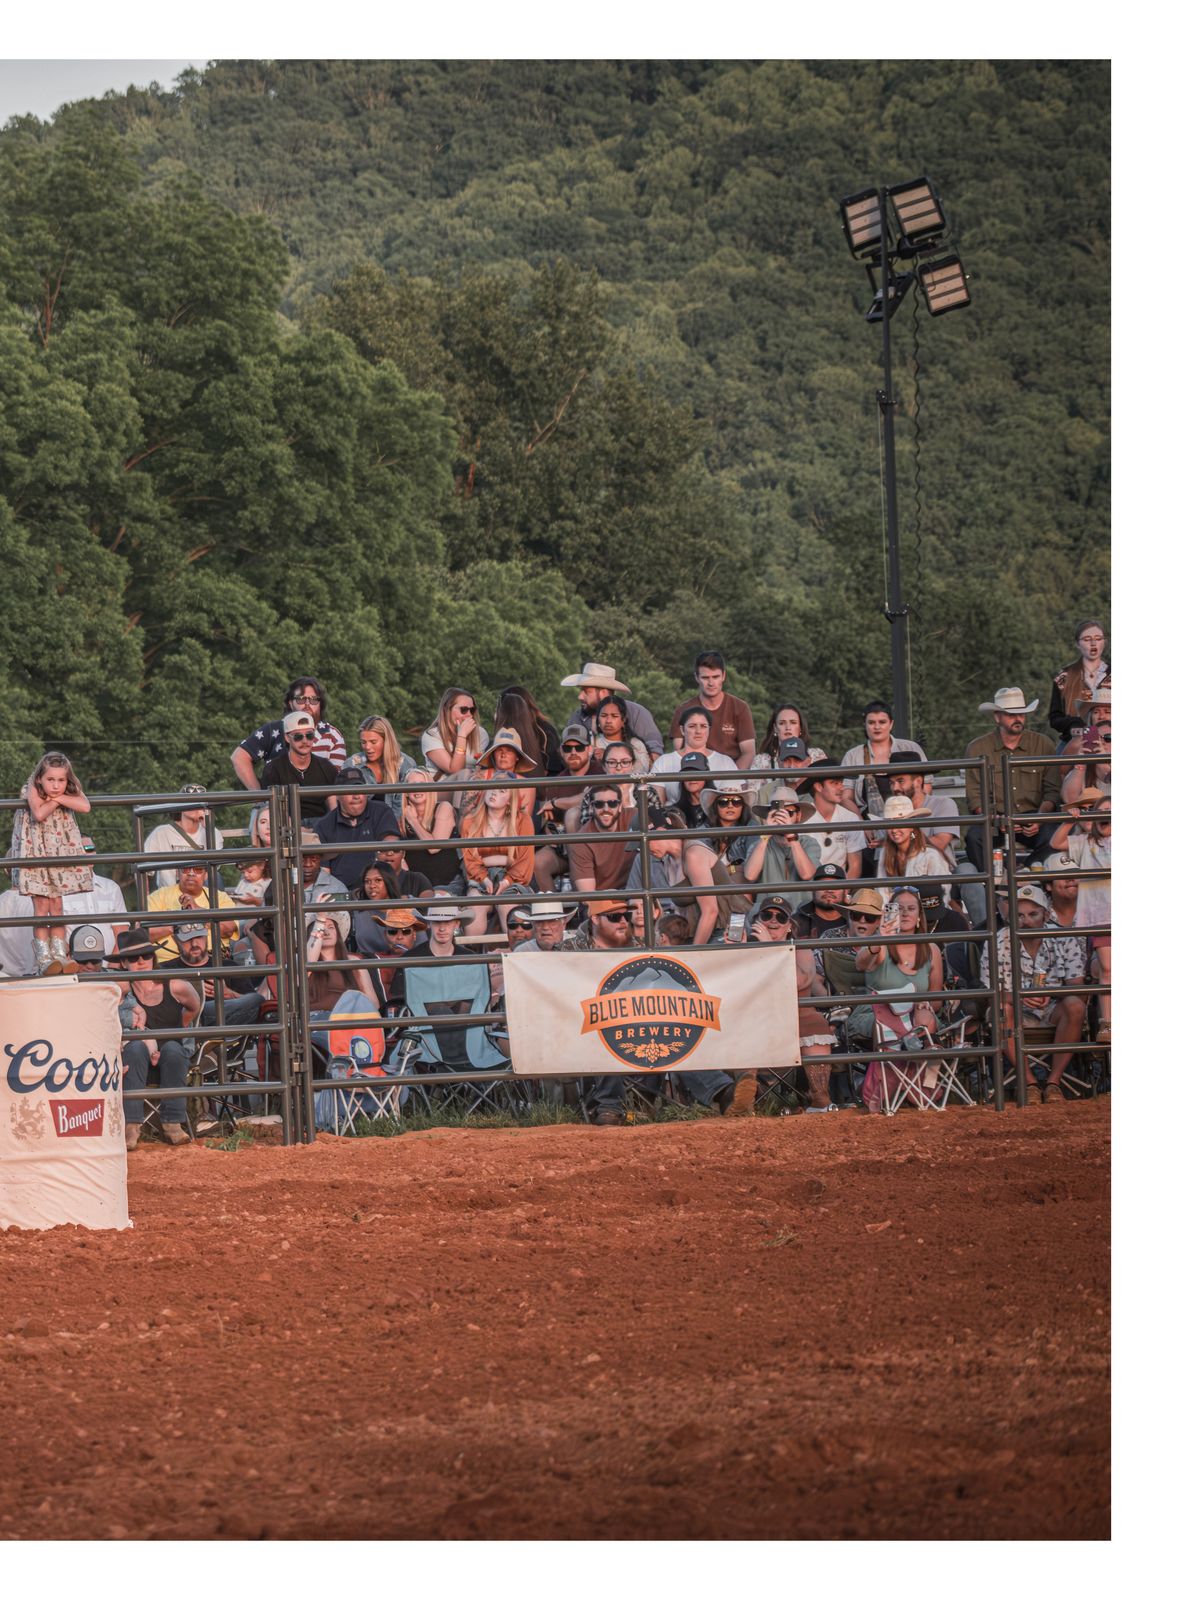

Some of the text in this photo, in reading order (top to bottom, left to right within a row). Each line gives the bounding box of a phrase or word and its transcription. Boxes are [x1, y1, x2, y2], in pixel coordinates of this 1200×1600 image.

[589, 995, 714, 1025] BLUE MOUNTAIN
[615, 1026, 692, 1040] BREWERY
[3, 1039, 120, 1094] Coors
[57, 1103, 102, 1134] Banquet
